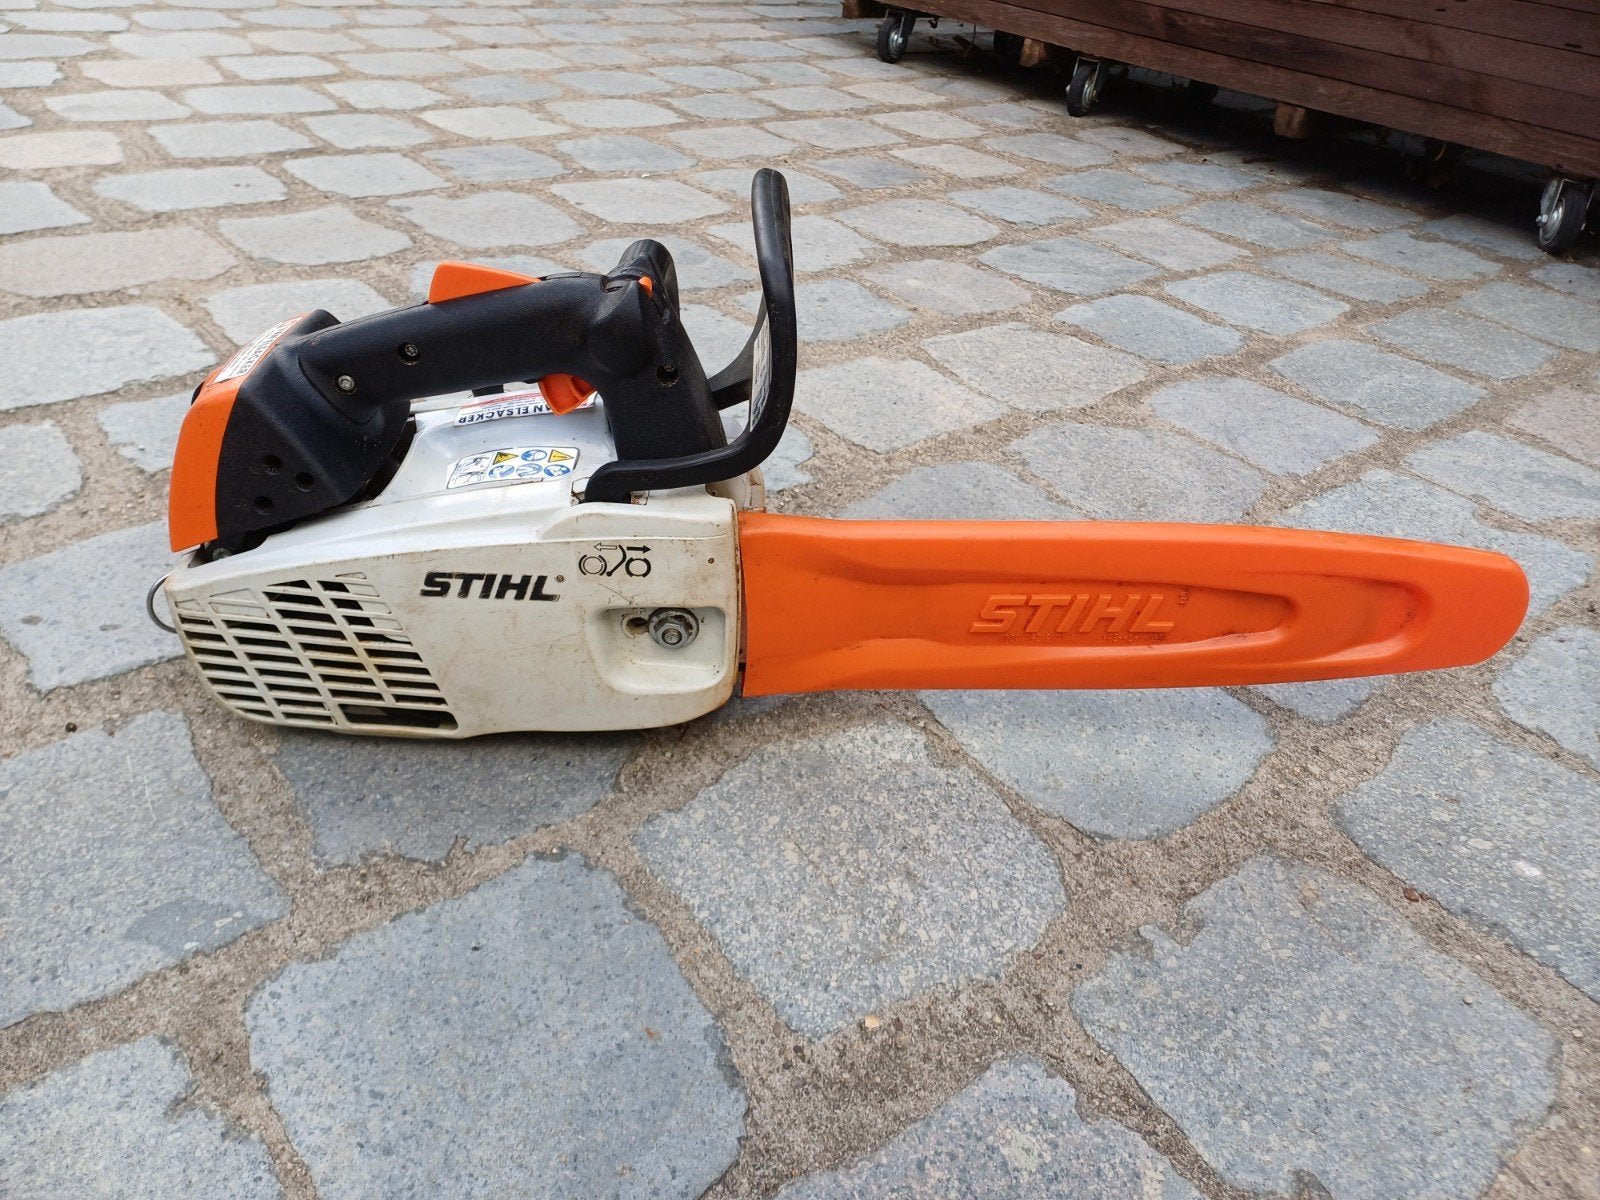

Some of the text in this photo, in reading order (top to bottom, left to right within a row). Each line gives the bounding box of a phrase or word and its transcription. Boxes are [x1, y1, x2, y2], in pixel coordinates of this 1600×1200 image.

[458, 406, 529, 424] ELSACKER
[419, 570, 561, 602] STIHL
[969, 593, 1175, 633] STIHL
